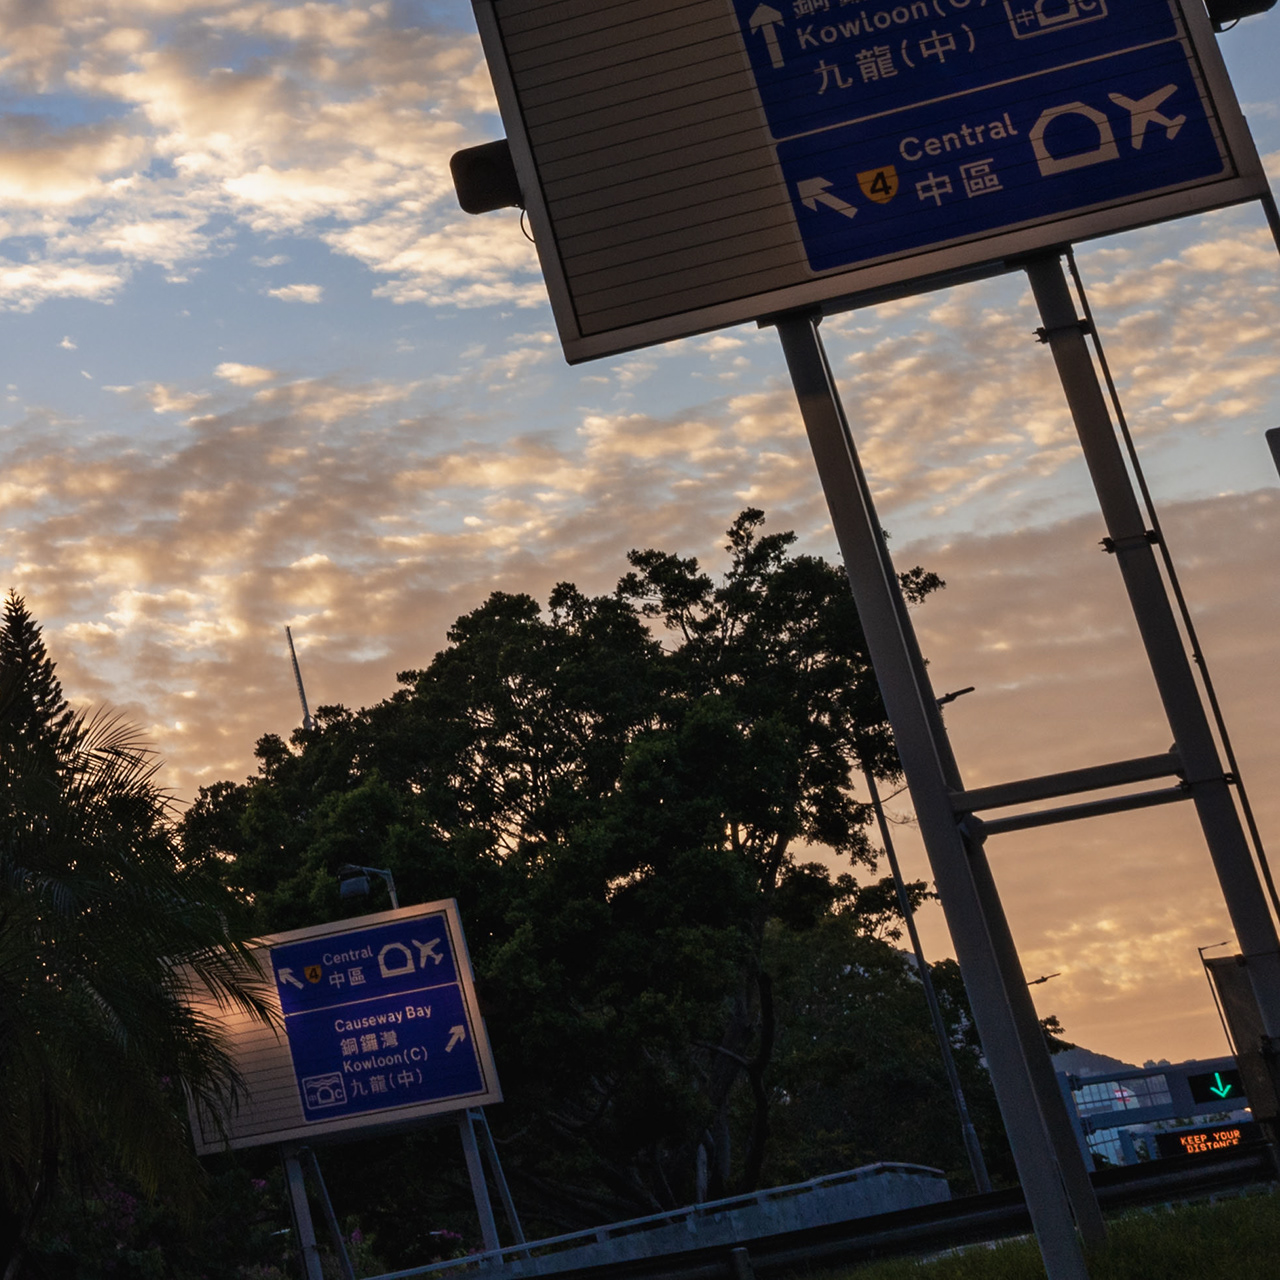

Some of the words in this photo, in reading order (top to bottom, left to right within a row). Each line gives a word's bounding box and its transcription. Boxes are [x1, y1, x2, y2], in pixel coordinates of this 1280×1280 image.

[1015, 8, 1035, 27] 中
[814, 23, 977, 95] 九龍(中)
[899, 112, 1018, 162] Central
[869, 170, 893, 202] 4
[915, 157, 1004, 208] 中區
[322, 945, 374, 966] Central
[309, 967, 319, 980] 4
[328, 966, 366, 989] 中區
[334, 1010, 403, 1032] Causeway
[405, 1005, 432, 1019] Bay
[340, 1030, 399, 1056] 銅鑼灣
[343, 1046, 428, 1073] Kowloon(C)
[1180, 1134, 1207, 1146] KEEP
[1213, 1129, 1241, 1141] YOUR
